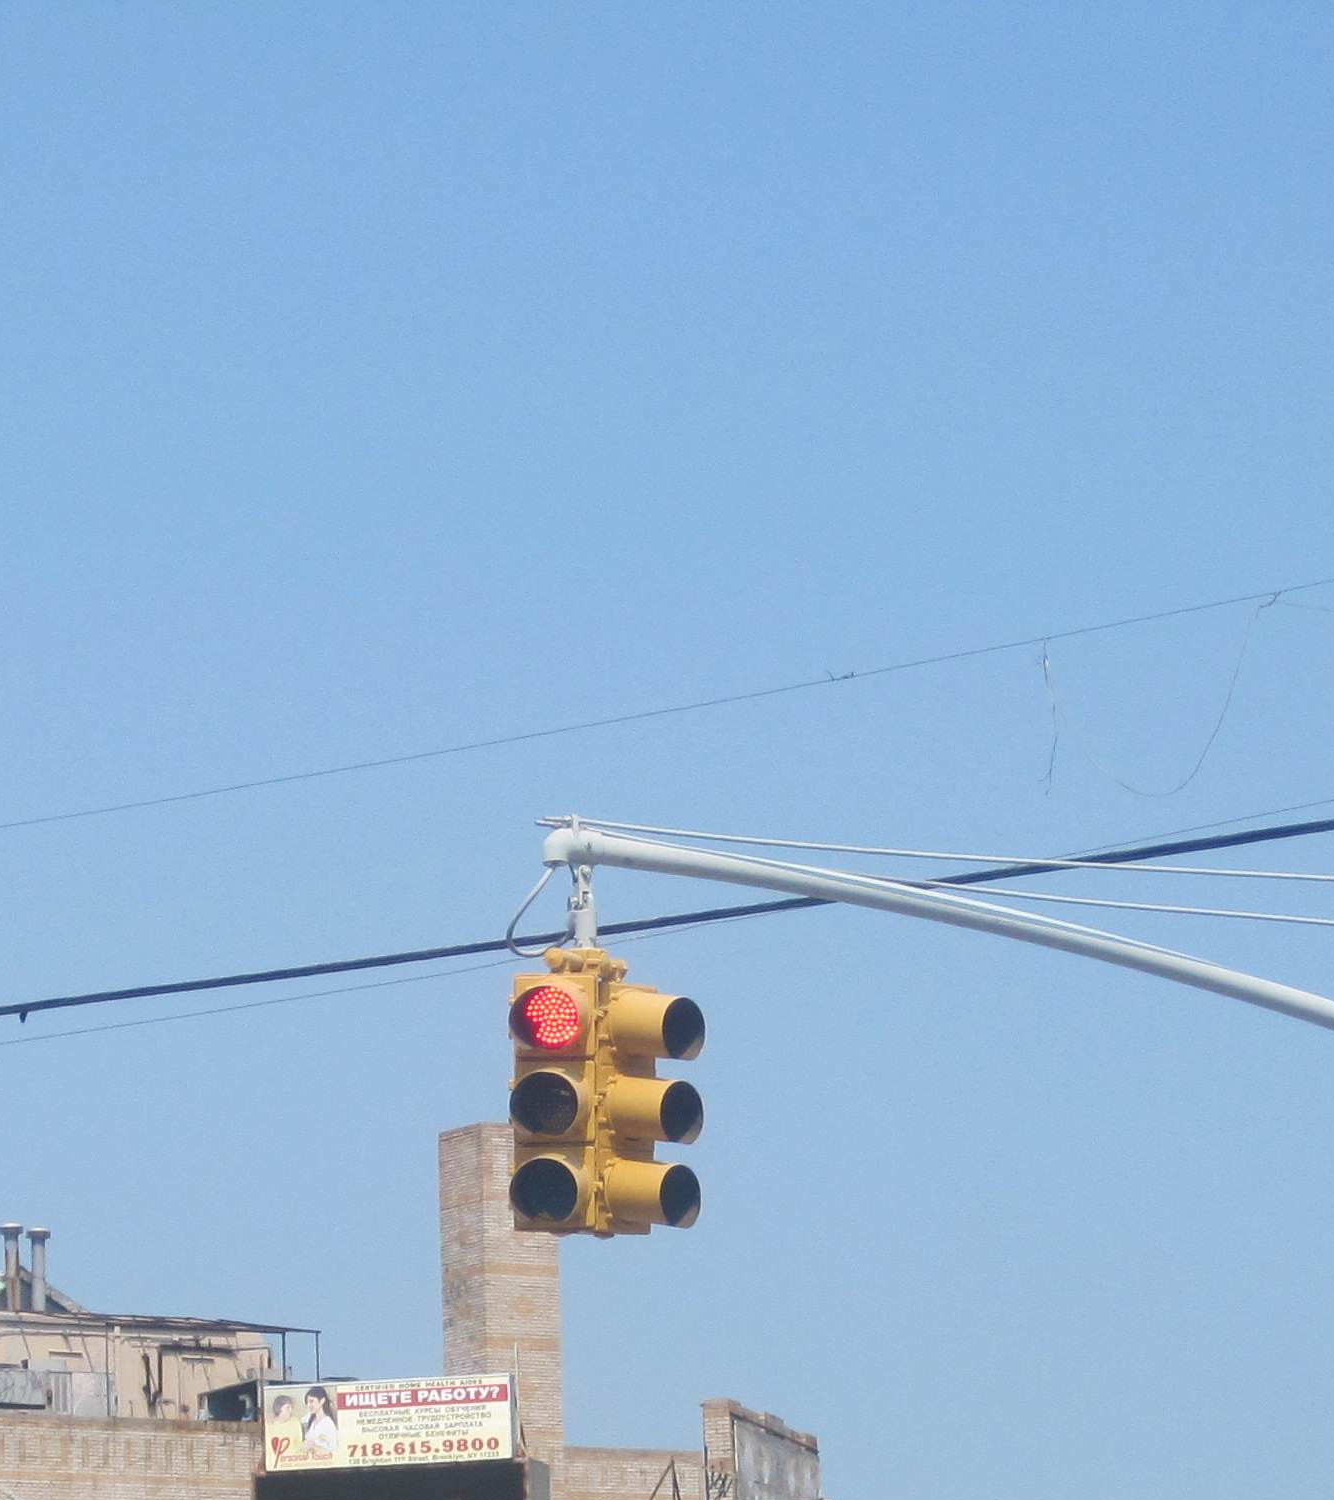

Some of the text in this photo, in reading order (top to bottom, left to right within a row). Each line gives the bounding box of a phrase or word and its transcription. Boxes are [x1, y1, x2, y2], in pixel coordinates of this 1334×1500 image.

[345, 1385, 500, 1408] ИЩЕТЕ РАБОТУ?
[347, 1437, 500, 1458] 718.615.9800
